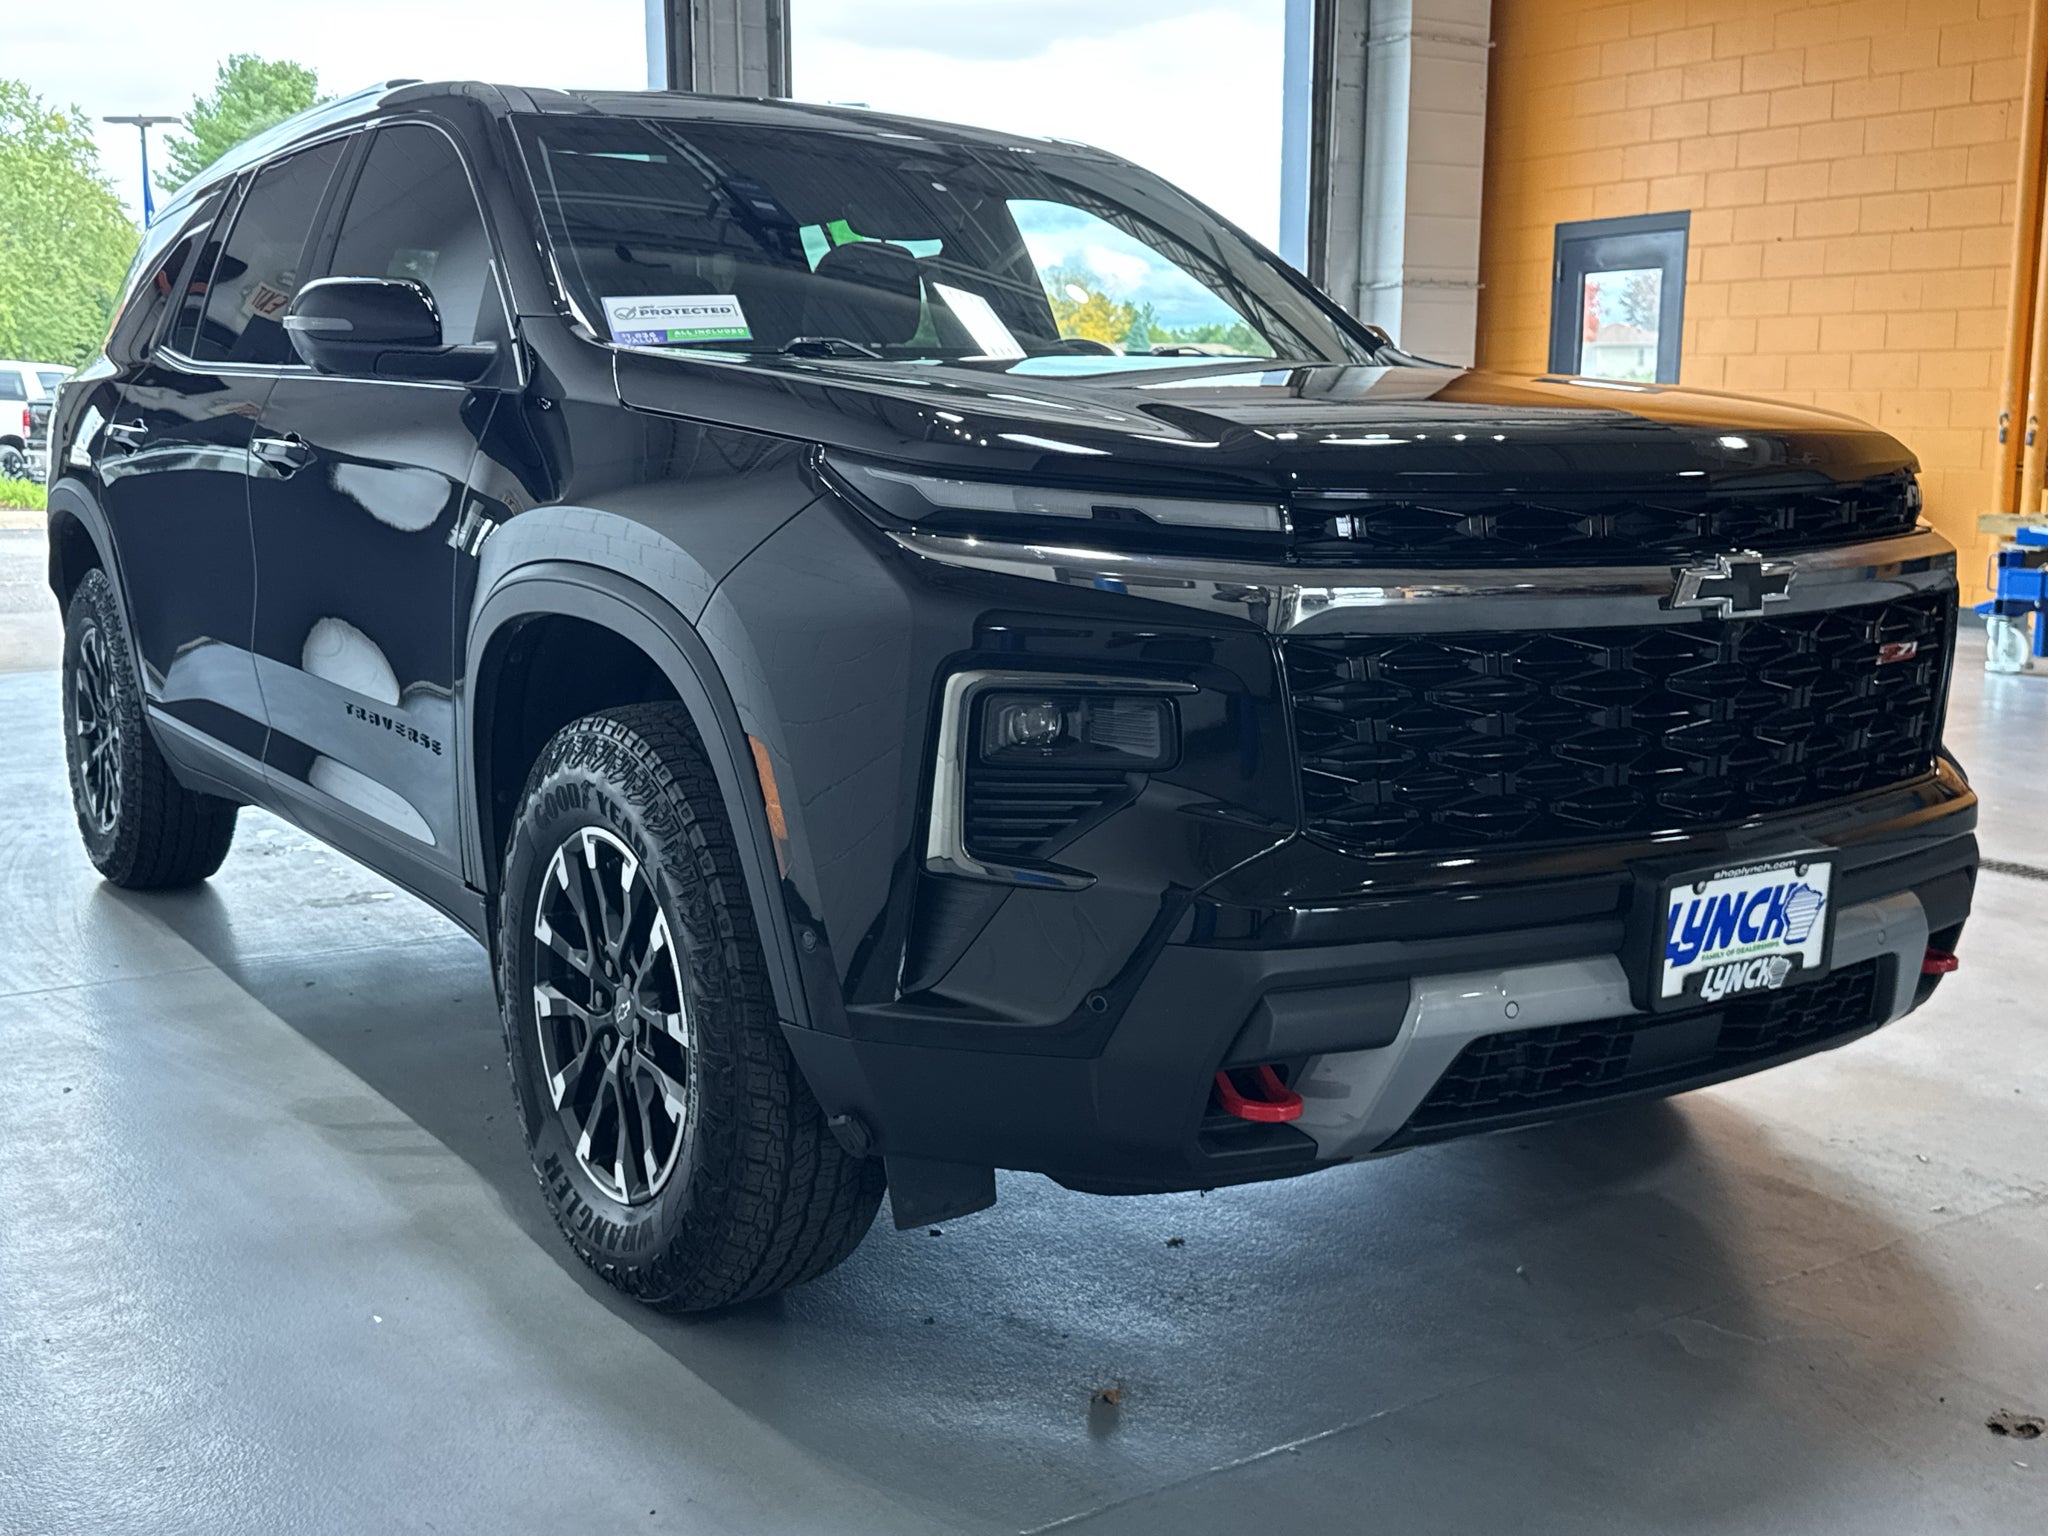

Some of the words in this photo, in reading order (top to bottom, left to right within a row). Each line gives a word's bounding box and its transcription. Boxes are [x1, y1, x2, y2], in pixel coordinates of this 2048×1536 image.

[639, 307, 731, 316] PROTECTED
[344, 701, 442, 755] TRAVERSE
[534, 780, 648, 860] GOODYEAR
[1713, 859, 1797, 880] shoplynch.com
[1665, 882, 1799, 968] LYNCH
[1701, 950, 1725, 961] FAMILY
[1736, 941, 1780, 955] DEALERSHIPS
[1701, 957, 1774, 1002] LYNCH
